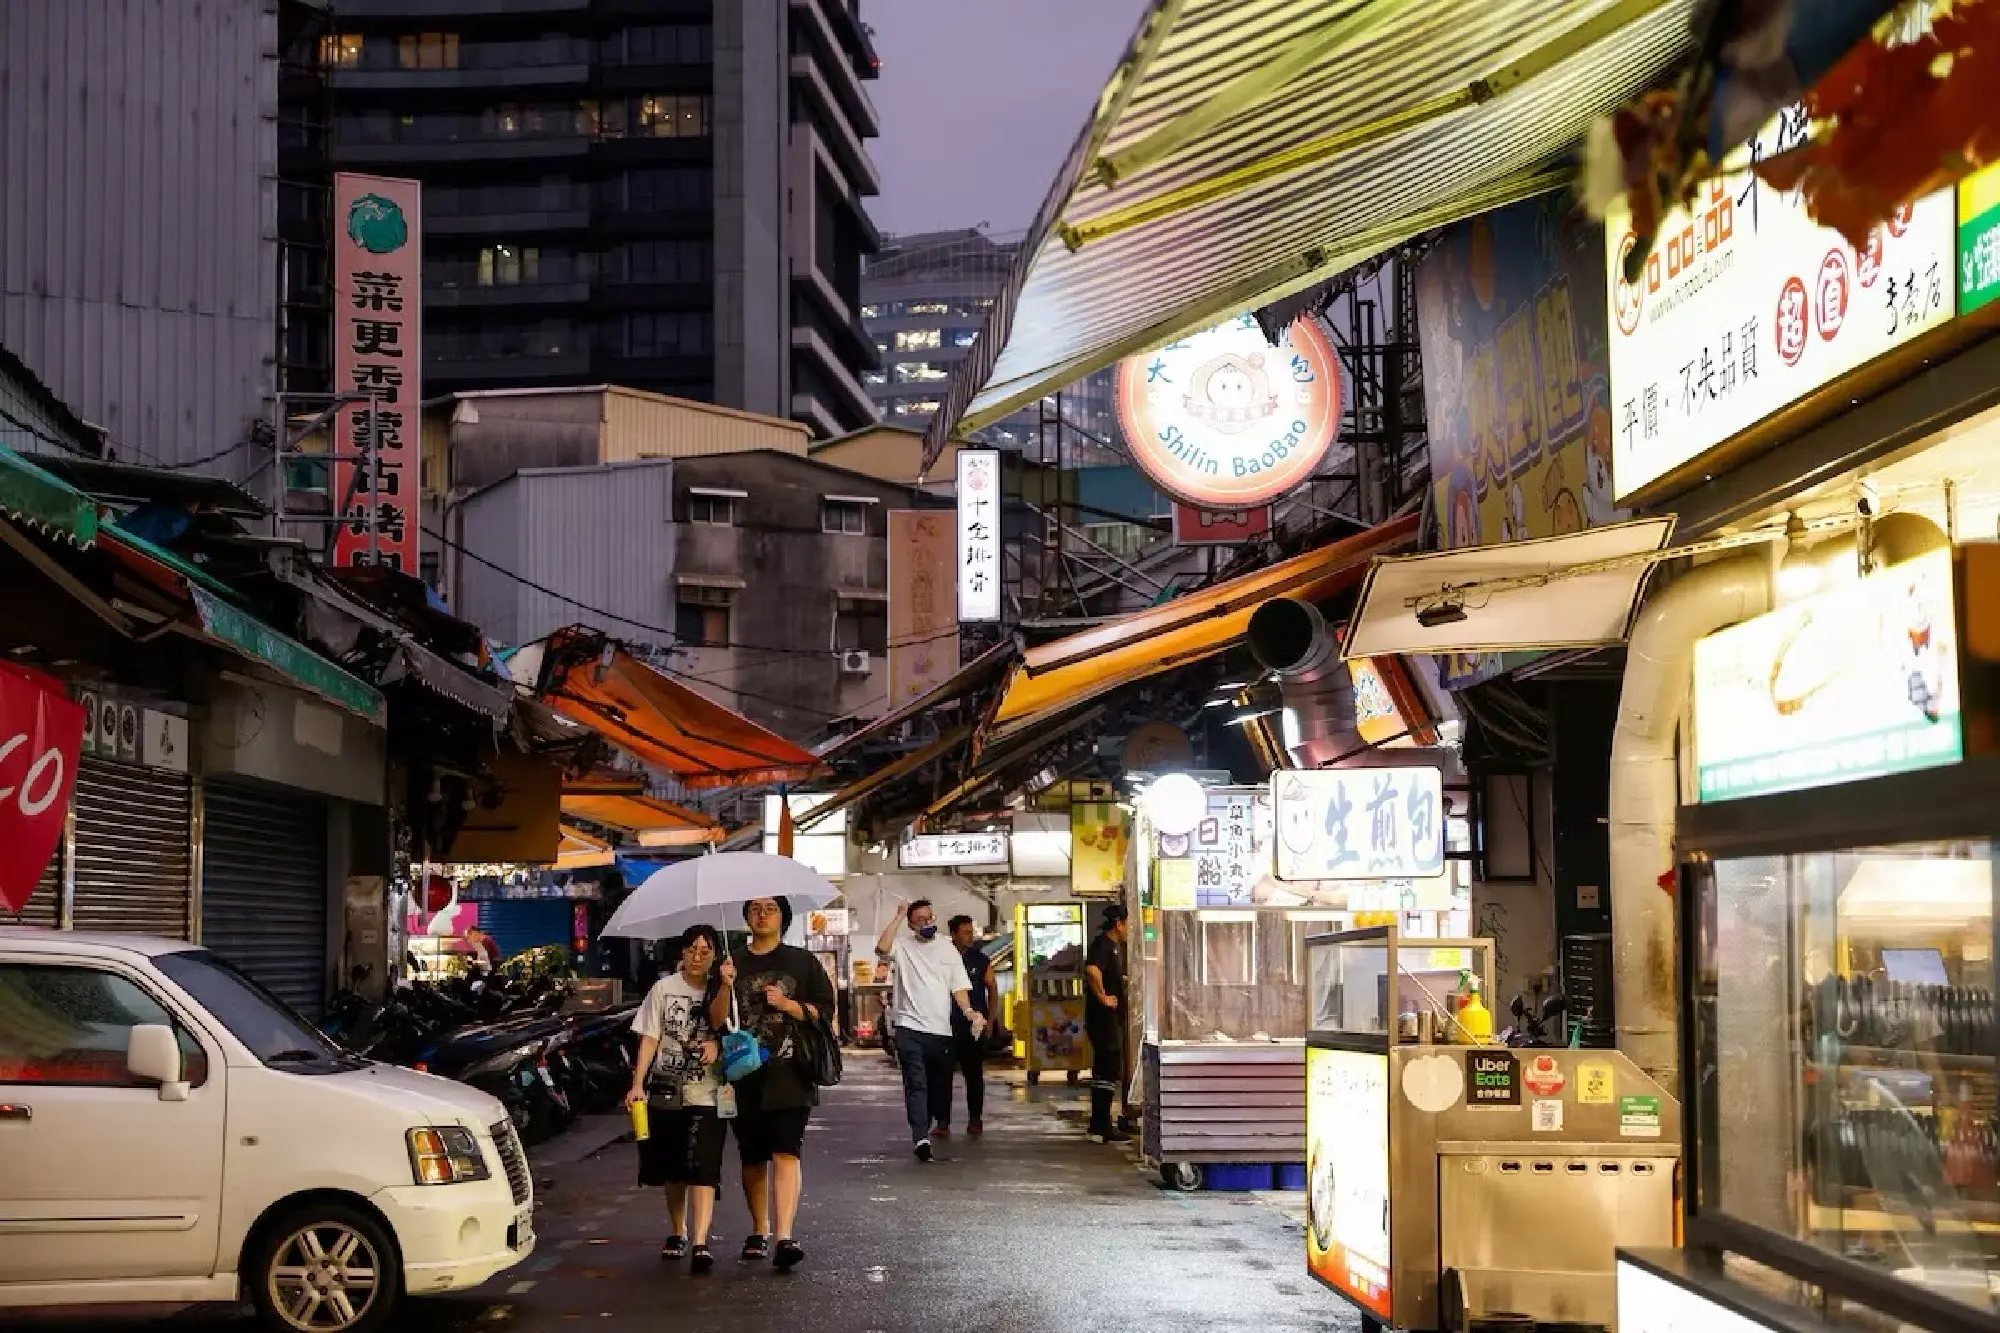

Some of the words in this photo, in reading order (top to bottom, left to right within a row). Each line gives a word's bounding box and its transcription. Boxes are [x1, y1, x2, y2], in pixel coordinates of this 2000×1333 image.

[1158, 424, 1219, 475] Shilin
[1232, 419, 1308, 477] BaoBao
[1325, 773, 1442, 873] 生煎包
[1474, 1057, 1511, 1072] Uber
[1475, 1072, 1511, 1086] Eats
